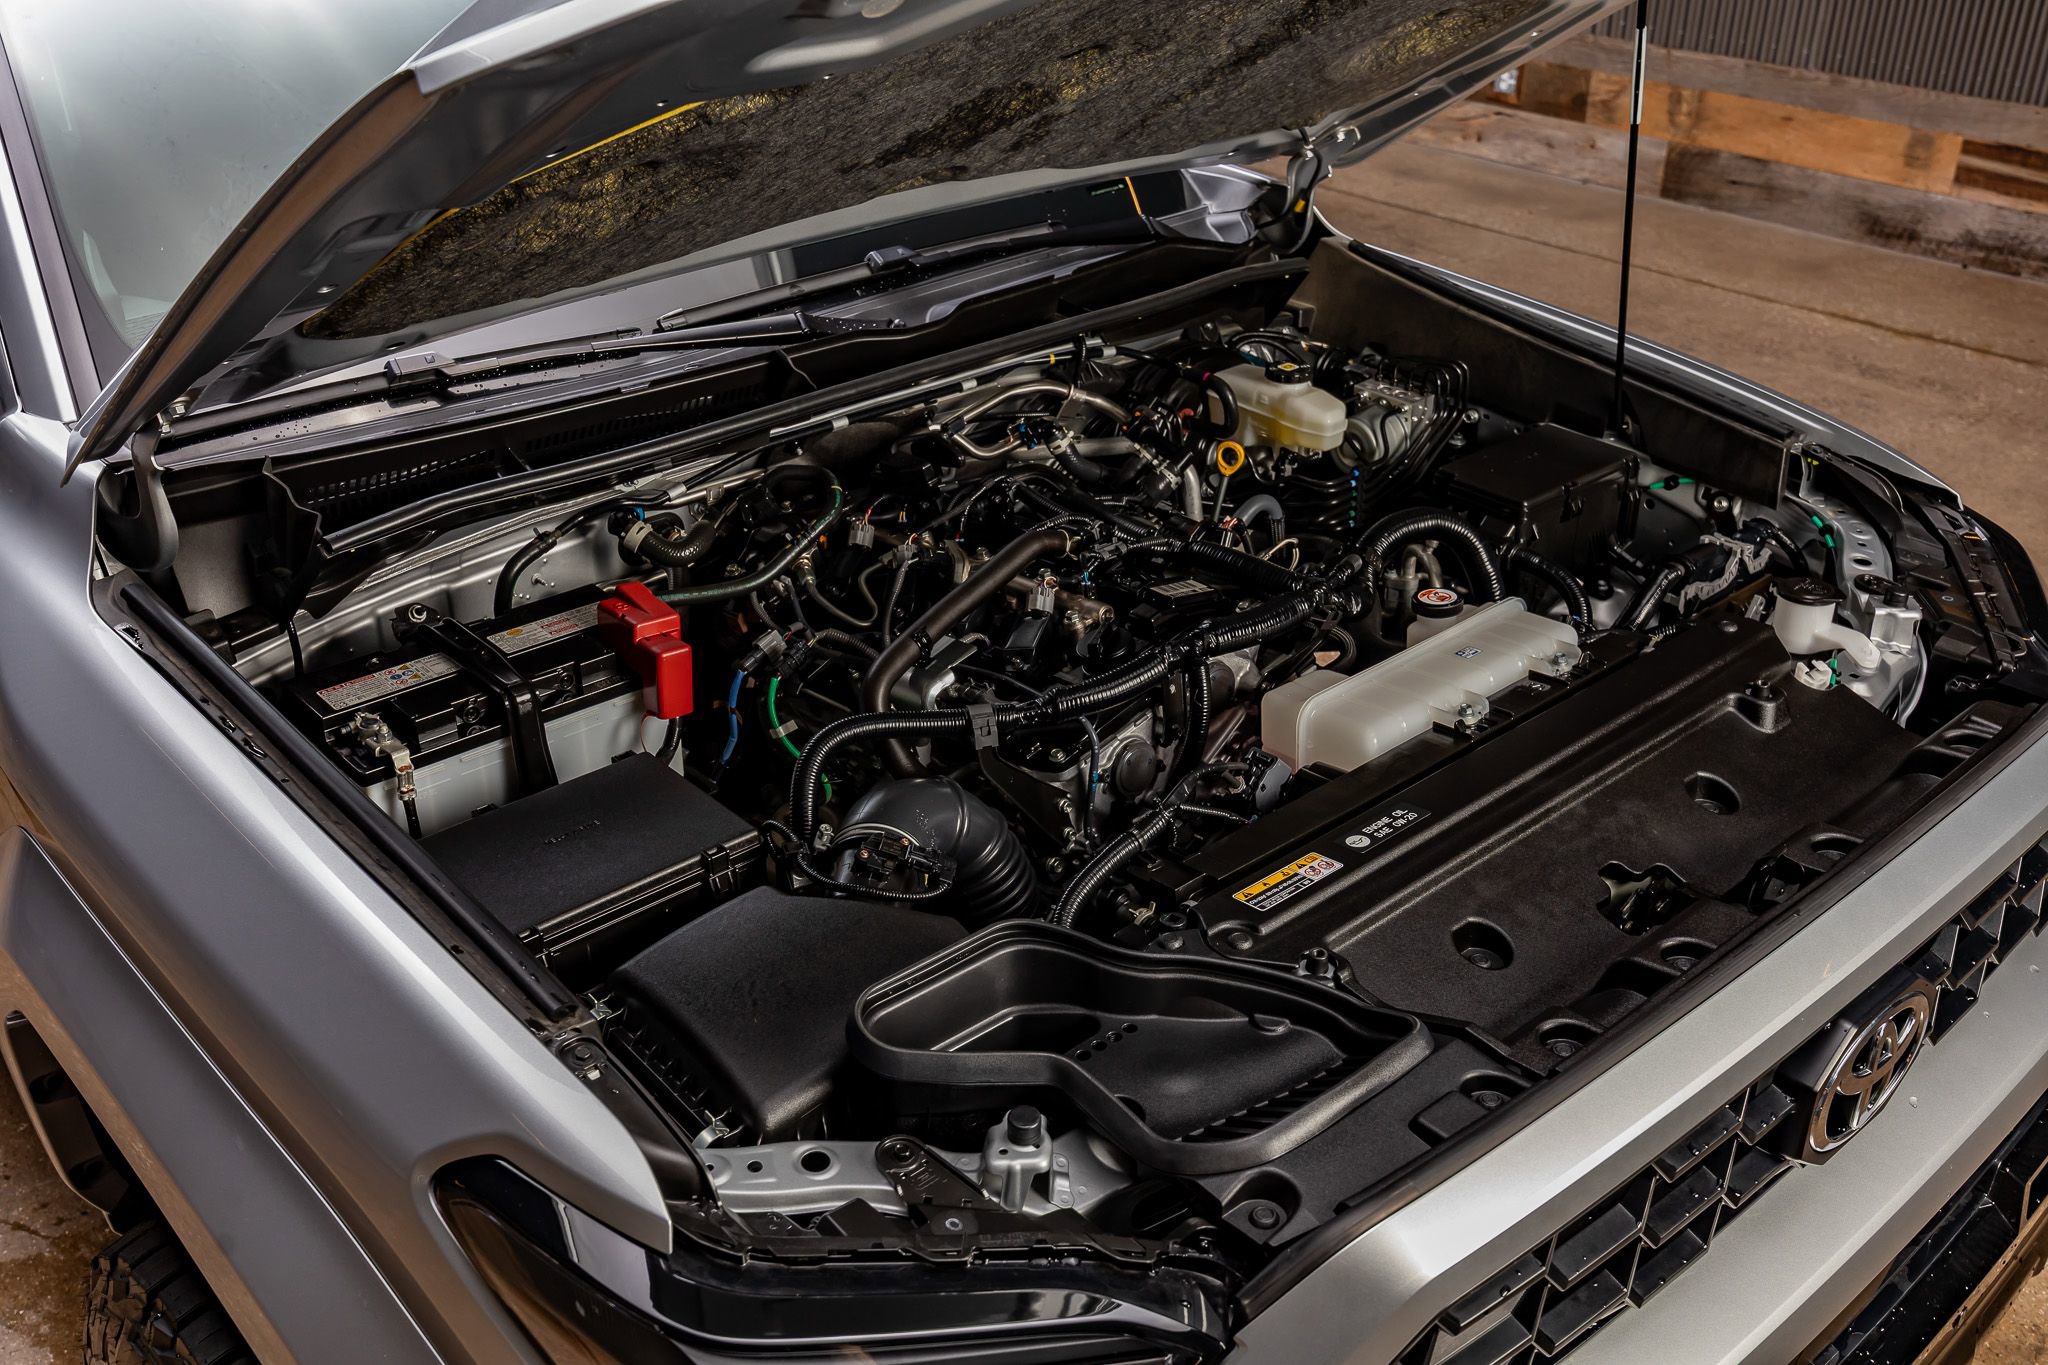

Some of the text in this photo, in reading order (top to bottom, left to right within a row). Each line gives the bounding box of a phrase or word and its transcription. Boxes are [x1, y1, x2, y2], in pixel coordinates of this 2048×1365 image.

[1362, 809, 1408, 834] ENGINE OIL
[1373, 812, 1418, 838] SAE 0W-20
